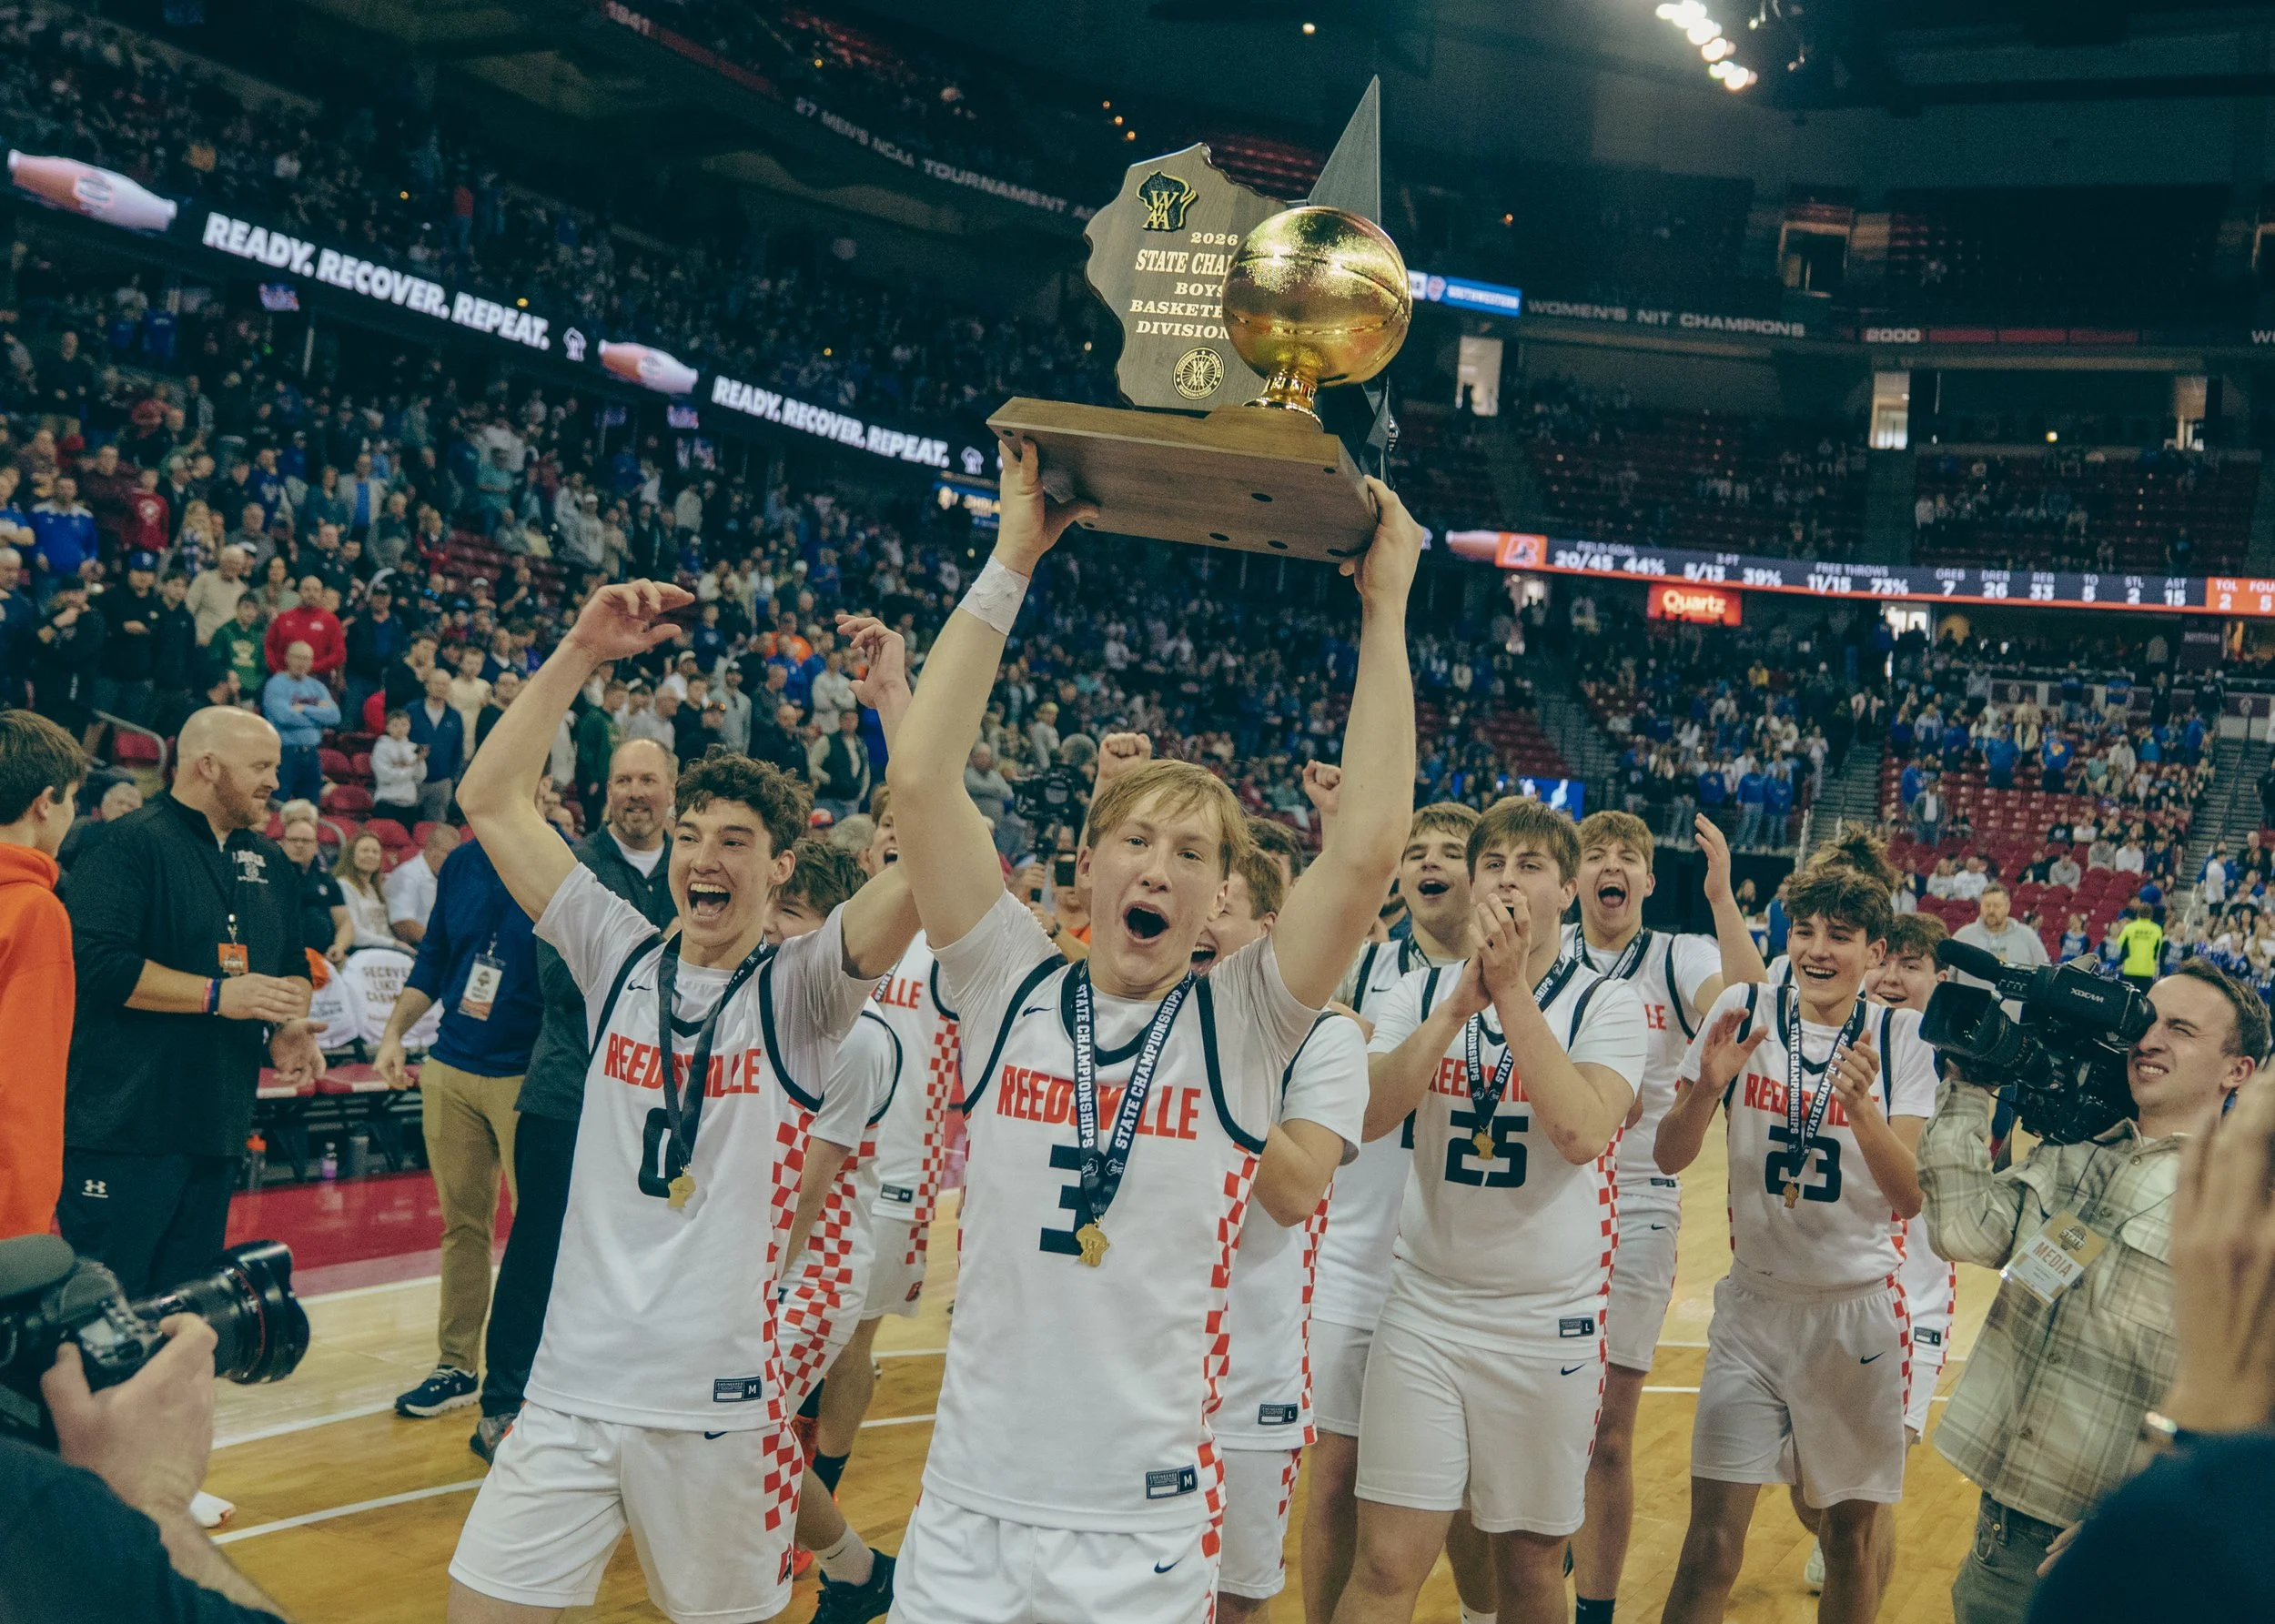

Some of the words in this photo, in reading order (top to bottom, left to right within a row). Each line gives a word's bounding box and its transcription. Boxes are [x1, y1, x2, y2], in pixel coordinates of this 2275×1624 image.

[872, 136, 915, 168] NCAA
[923, 157, 1067, 213] TOURNAMENT
[1190, 231, 1239, 246] 2026
[1135, 248, 1189, 273] STATE
[202, 212, 316, 277] READY.
[316, 247, 450, 319] RECOVER.
[451, 291, 551, 351] REPEAT.
[1136, 320, 1230, 340] DIVISION
[1529, 300, 1628, 321] WOMEN'S
[1637, 309, 1672, 326] NIT
[1680, 313, 1805, 338] CHAMPIONS
[712, 375, 783, 422] READY.
[781, 398, 866, 449] RECOVER.
[866, 424, 950, 468] REPEAT.
[1623, 556, 1666, 577] 44%
[1815, 561, 1843, 576] FREE
[1845, 563, 1889, 578] THROWS
[2032, 571, 2056, 584] REB
[1806, 573, 1853, 595] 11/15
[1870, 577, 1909, 597] 73%
[1942, 580, 1956, 598] 7
[1982, 580, 2008, 600] 26
[2083, 573, 2099, 586] TO
[2125, 575, 2145, 589] STL
[2164, 577, 2188, 590] AST
[1663, 590, 1726, 614] Quartz
[2029, 582, 2055, 601] 33
[2127, 587, 2140, 605] 2
[2164, 589, 2186, 607] 15
[2219, 592, 2232, 610] 2
[1076, 983, 1090, 1024] STATE
[1790, 1023, 1800, 1053] STATE
[604, 1032, 762, 1098] REEDILLE
[1115, 1098, 1138, 1150] STATE
[1130, 989, 1183, 1098] CHAMPIONSHIPS
[1077, 1024, 1095, 1149] CHAMPIONSHIPS
[1790, 1054, 1800, 1135] CHAMPIONSHIPS
[996, 1064, 1202, 1141] REEDVLLE
[1806, 1105, 1822, 1138] STATE
[1445, 1109, 1530, 1189] 25
[1765, 1125, 1842, 1204] 23
[1039, 1144, 1096, 1257] 3
[2060, 1228, 2085, 1248] STATE
[2032, 1241, 2073, 1277] MEDIA
[1585, 1323, 1591, 1331] L
[748, 1384, 757, 1395] M
[1288, 1410, 1294, 1419] L
[1184, 1474, 1193, 1488] M
